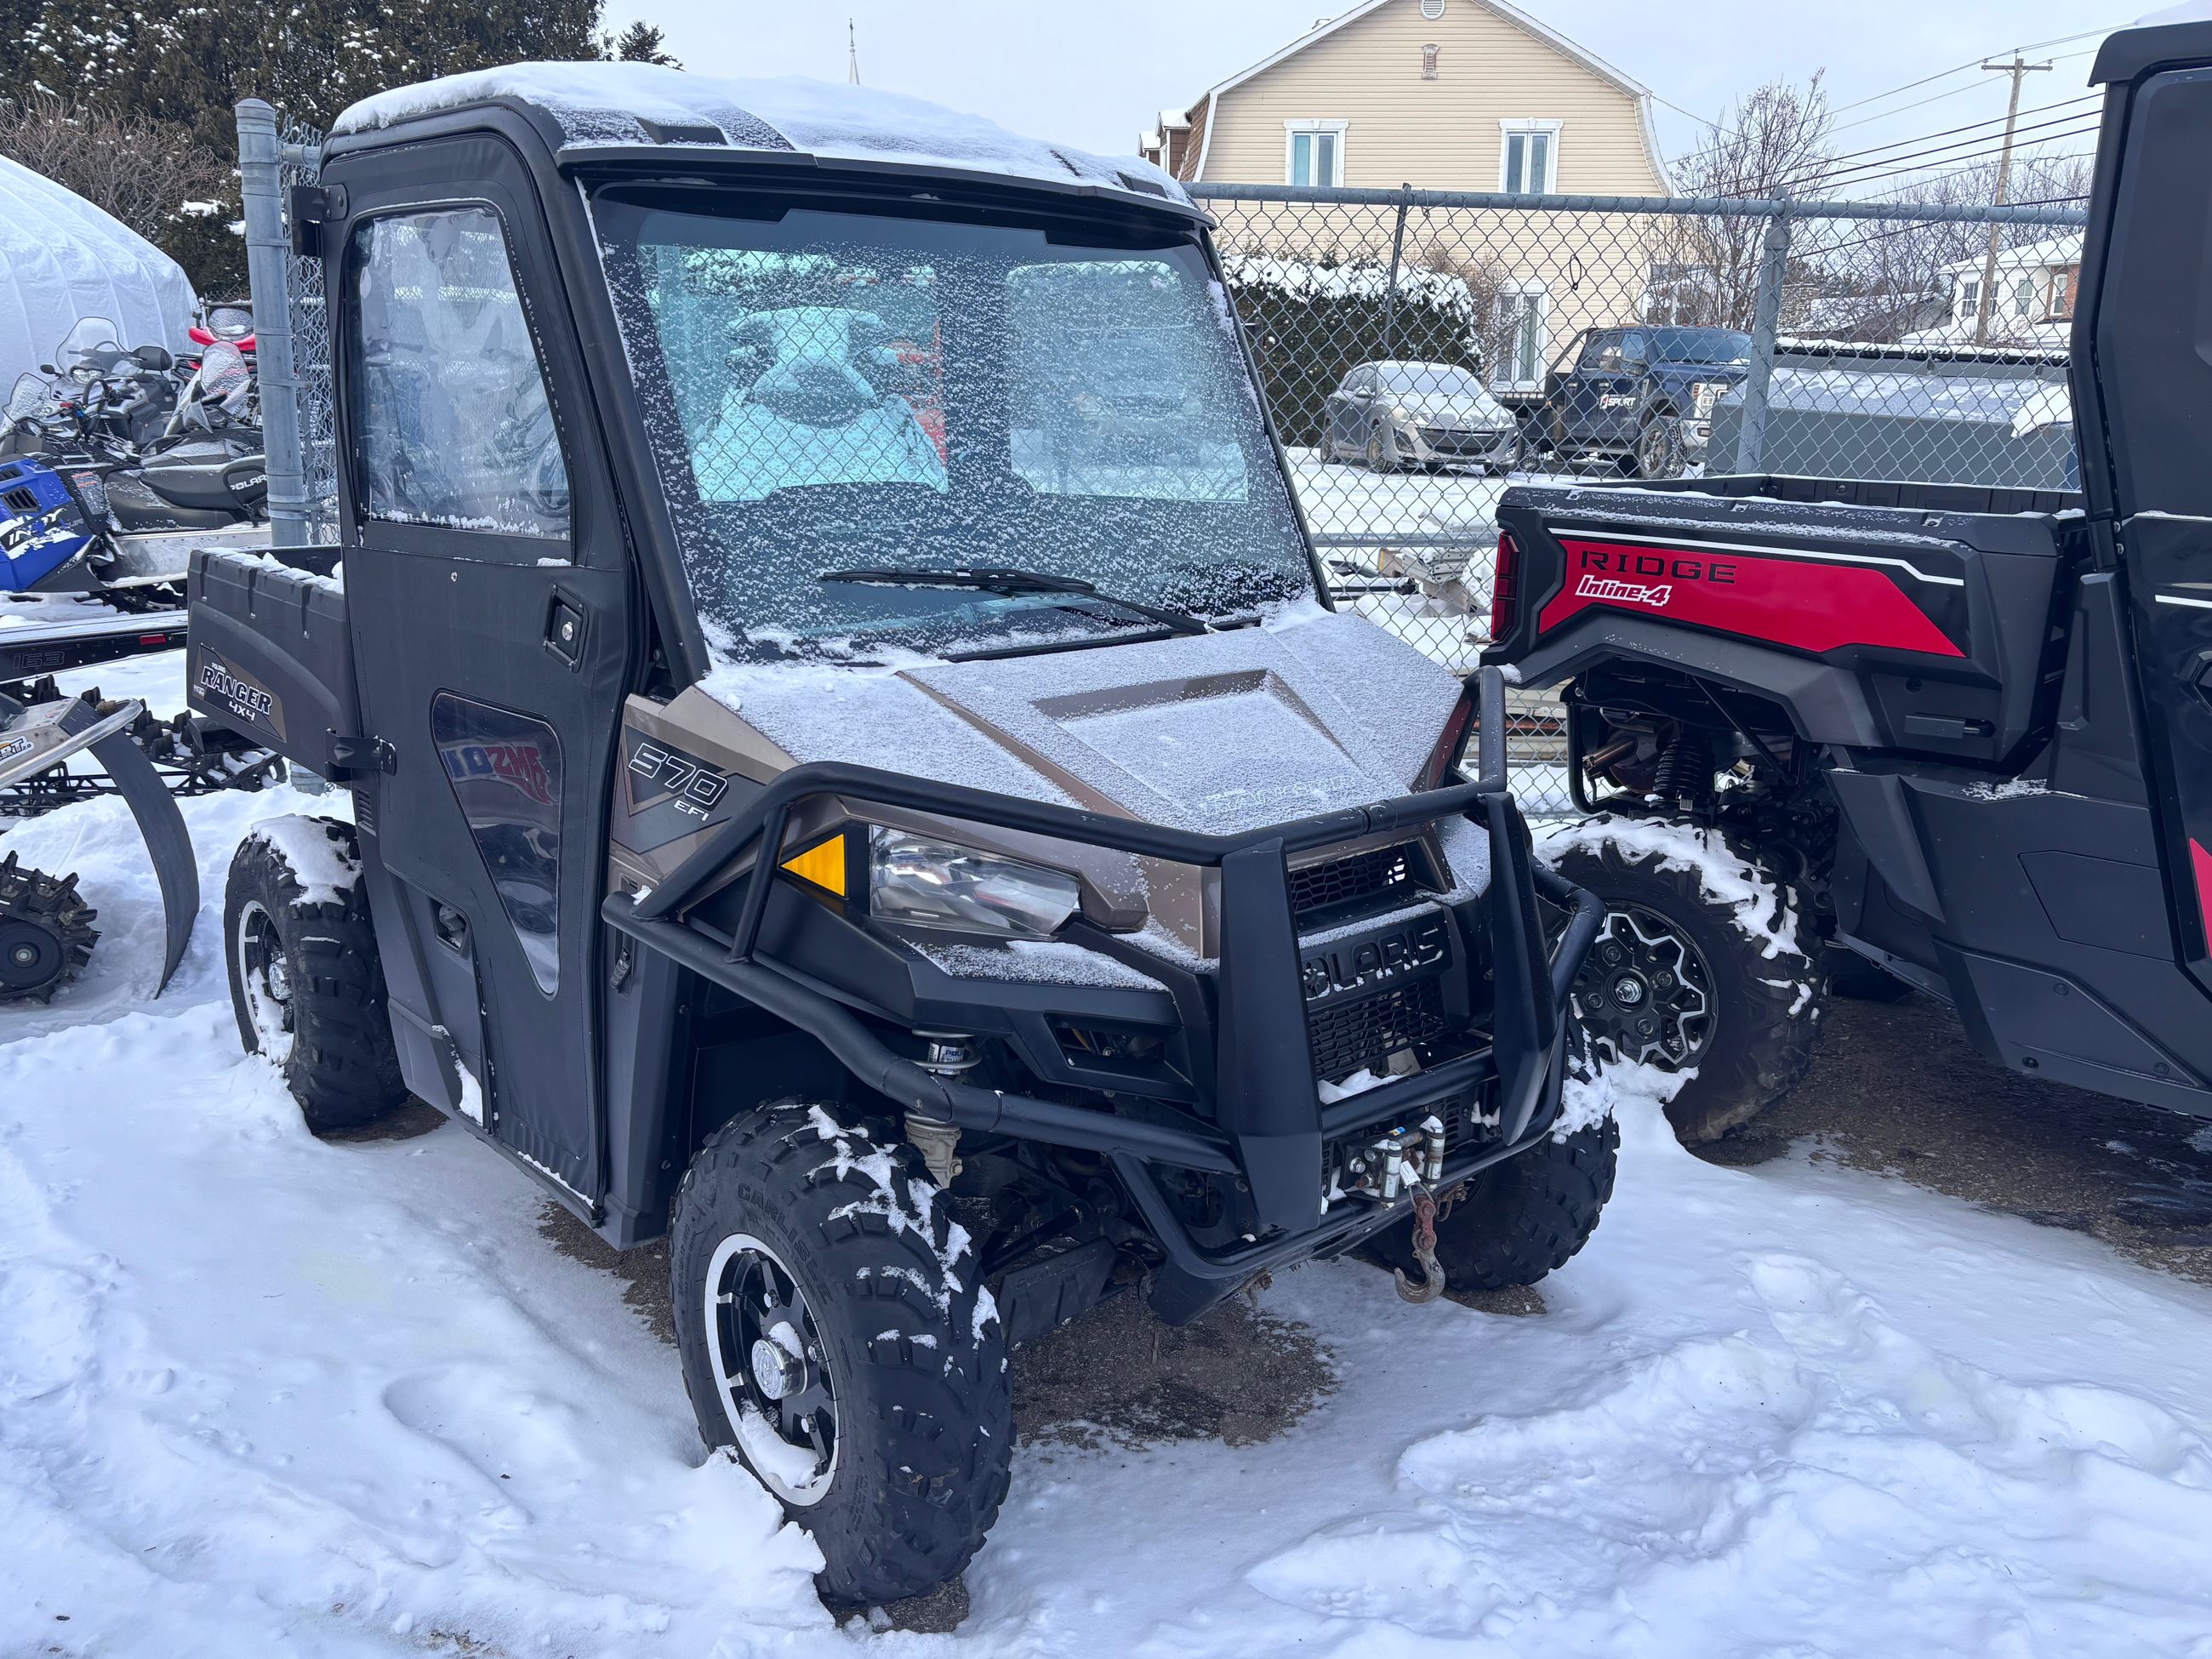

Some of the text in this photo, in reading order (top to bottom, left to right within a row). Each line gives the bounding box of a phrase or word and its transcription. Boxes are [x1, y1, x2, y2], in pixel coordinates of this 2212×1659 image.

[1581, 550, 1736, 584] RIDGE
[1575, 574, 1673, 607] Inline-4
[14, 651, 66, 669] 163
[201, 665, 272, 715] RANGER
[628, 743, 727, 806] 570
[674, 800, 709, 821] EFI
[1302, 922, 1445, 1001] OLARIS
[738, 1183, 834, 1306] CARLISLE
